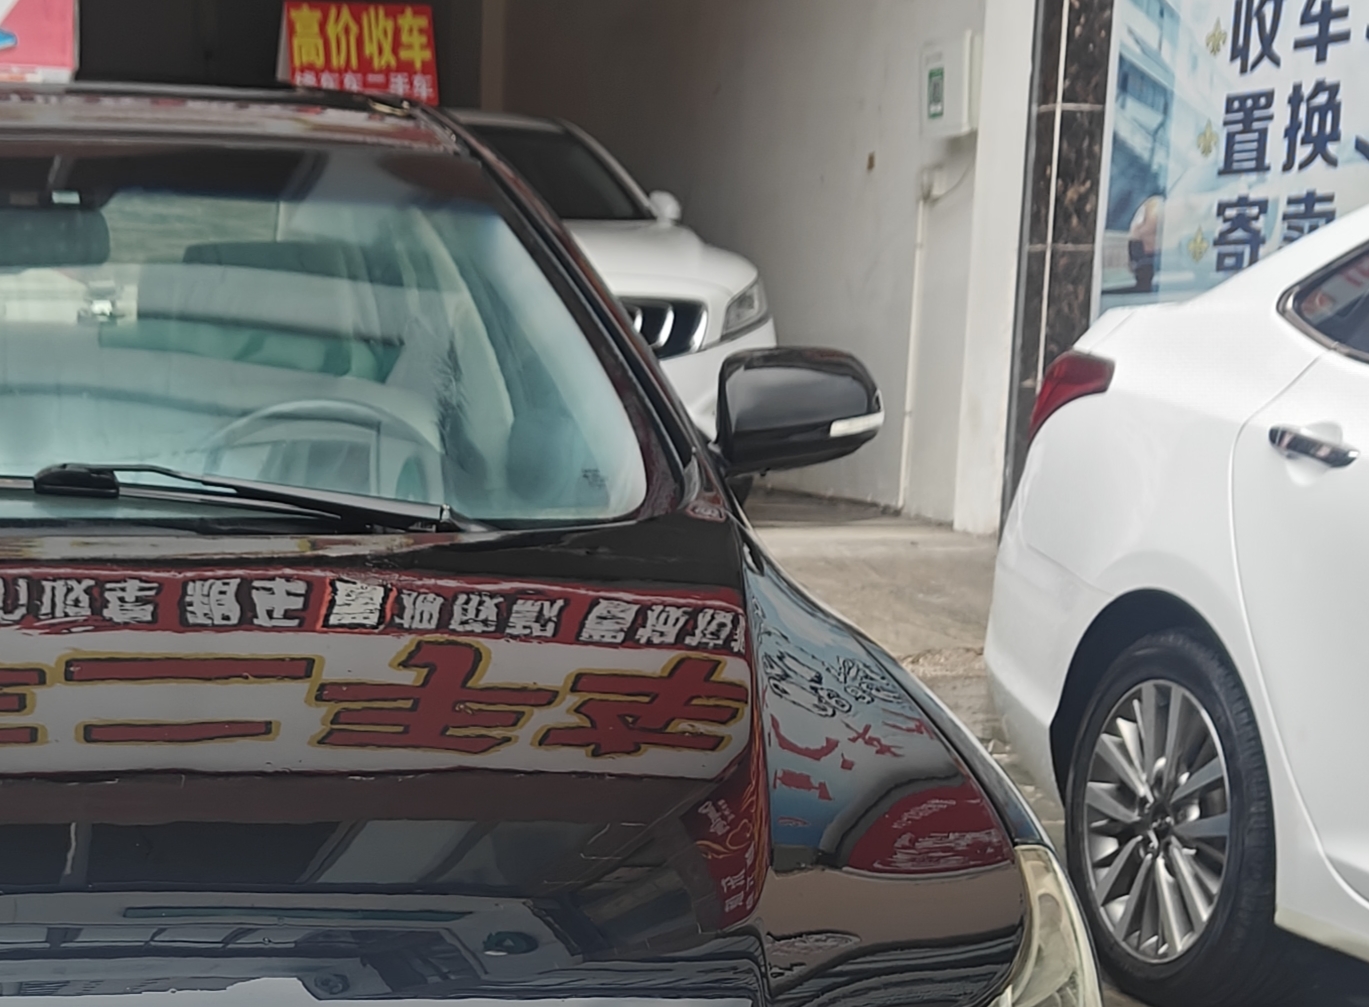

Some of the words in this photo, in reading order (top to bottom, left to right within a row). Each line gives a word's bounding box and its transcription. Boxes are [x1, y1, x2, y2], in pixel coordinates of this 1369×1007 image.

[290, 3, 431, 69] 高价收车
[1230, 0, 1369, 74] 收车
